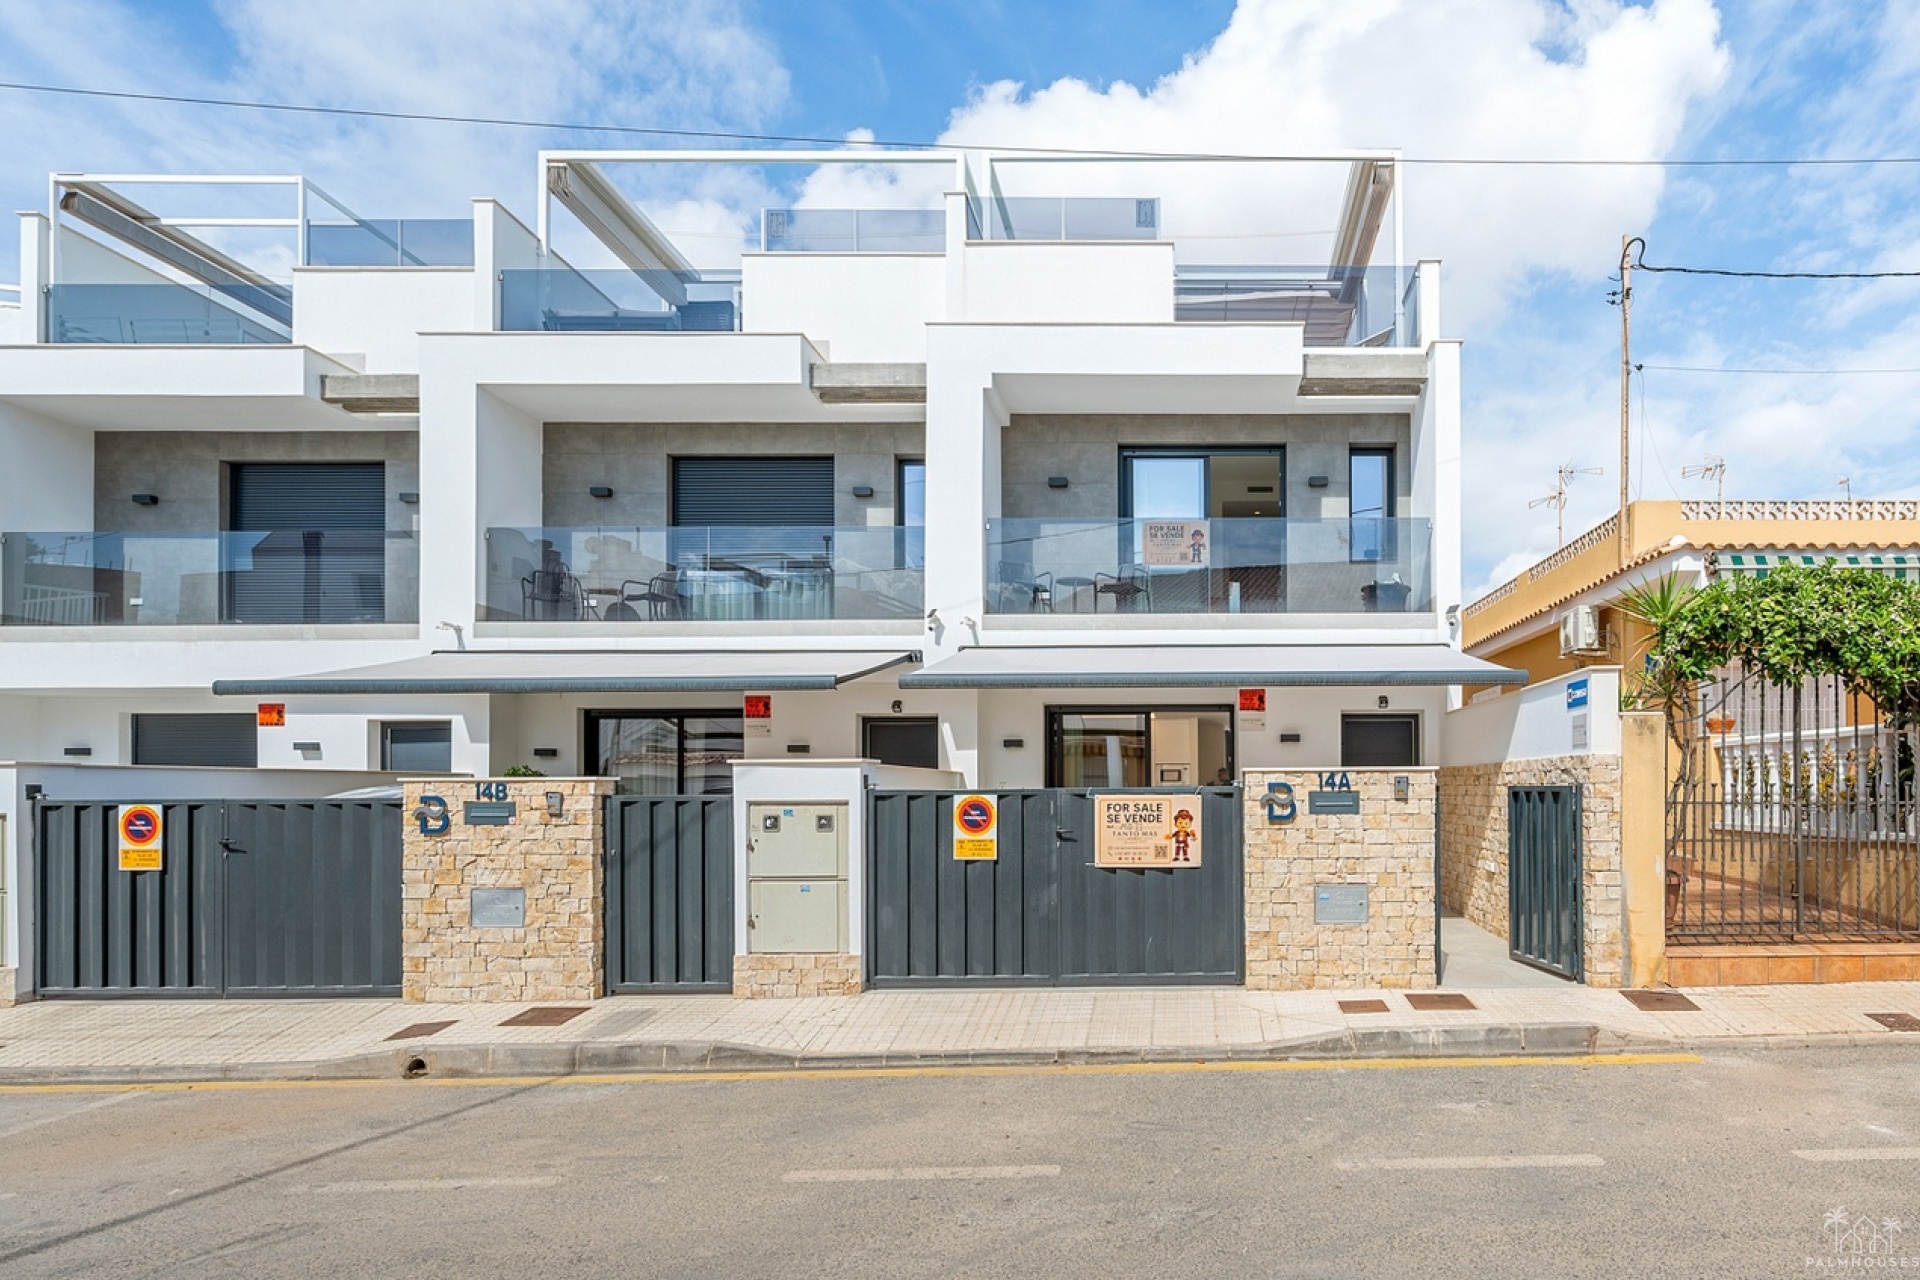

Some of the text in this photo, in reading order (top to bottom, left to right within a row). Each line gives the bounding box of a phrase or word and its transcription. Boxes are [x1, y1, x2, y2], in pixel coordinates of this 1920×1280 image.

[1317, 772, 1351, 790] 14A
[474, 783, 508, 800] 14B
[1106, 803, 1163, 813] FOR SALE
[1106, 813, 1163, 823] SE VENDE
